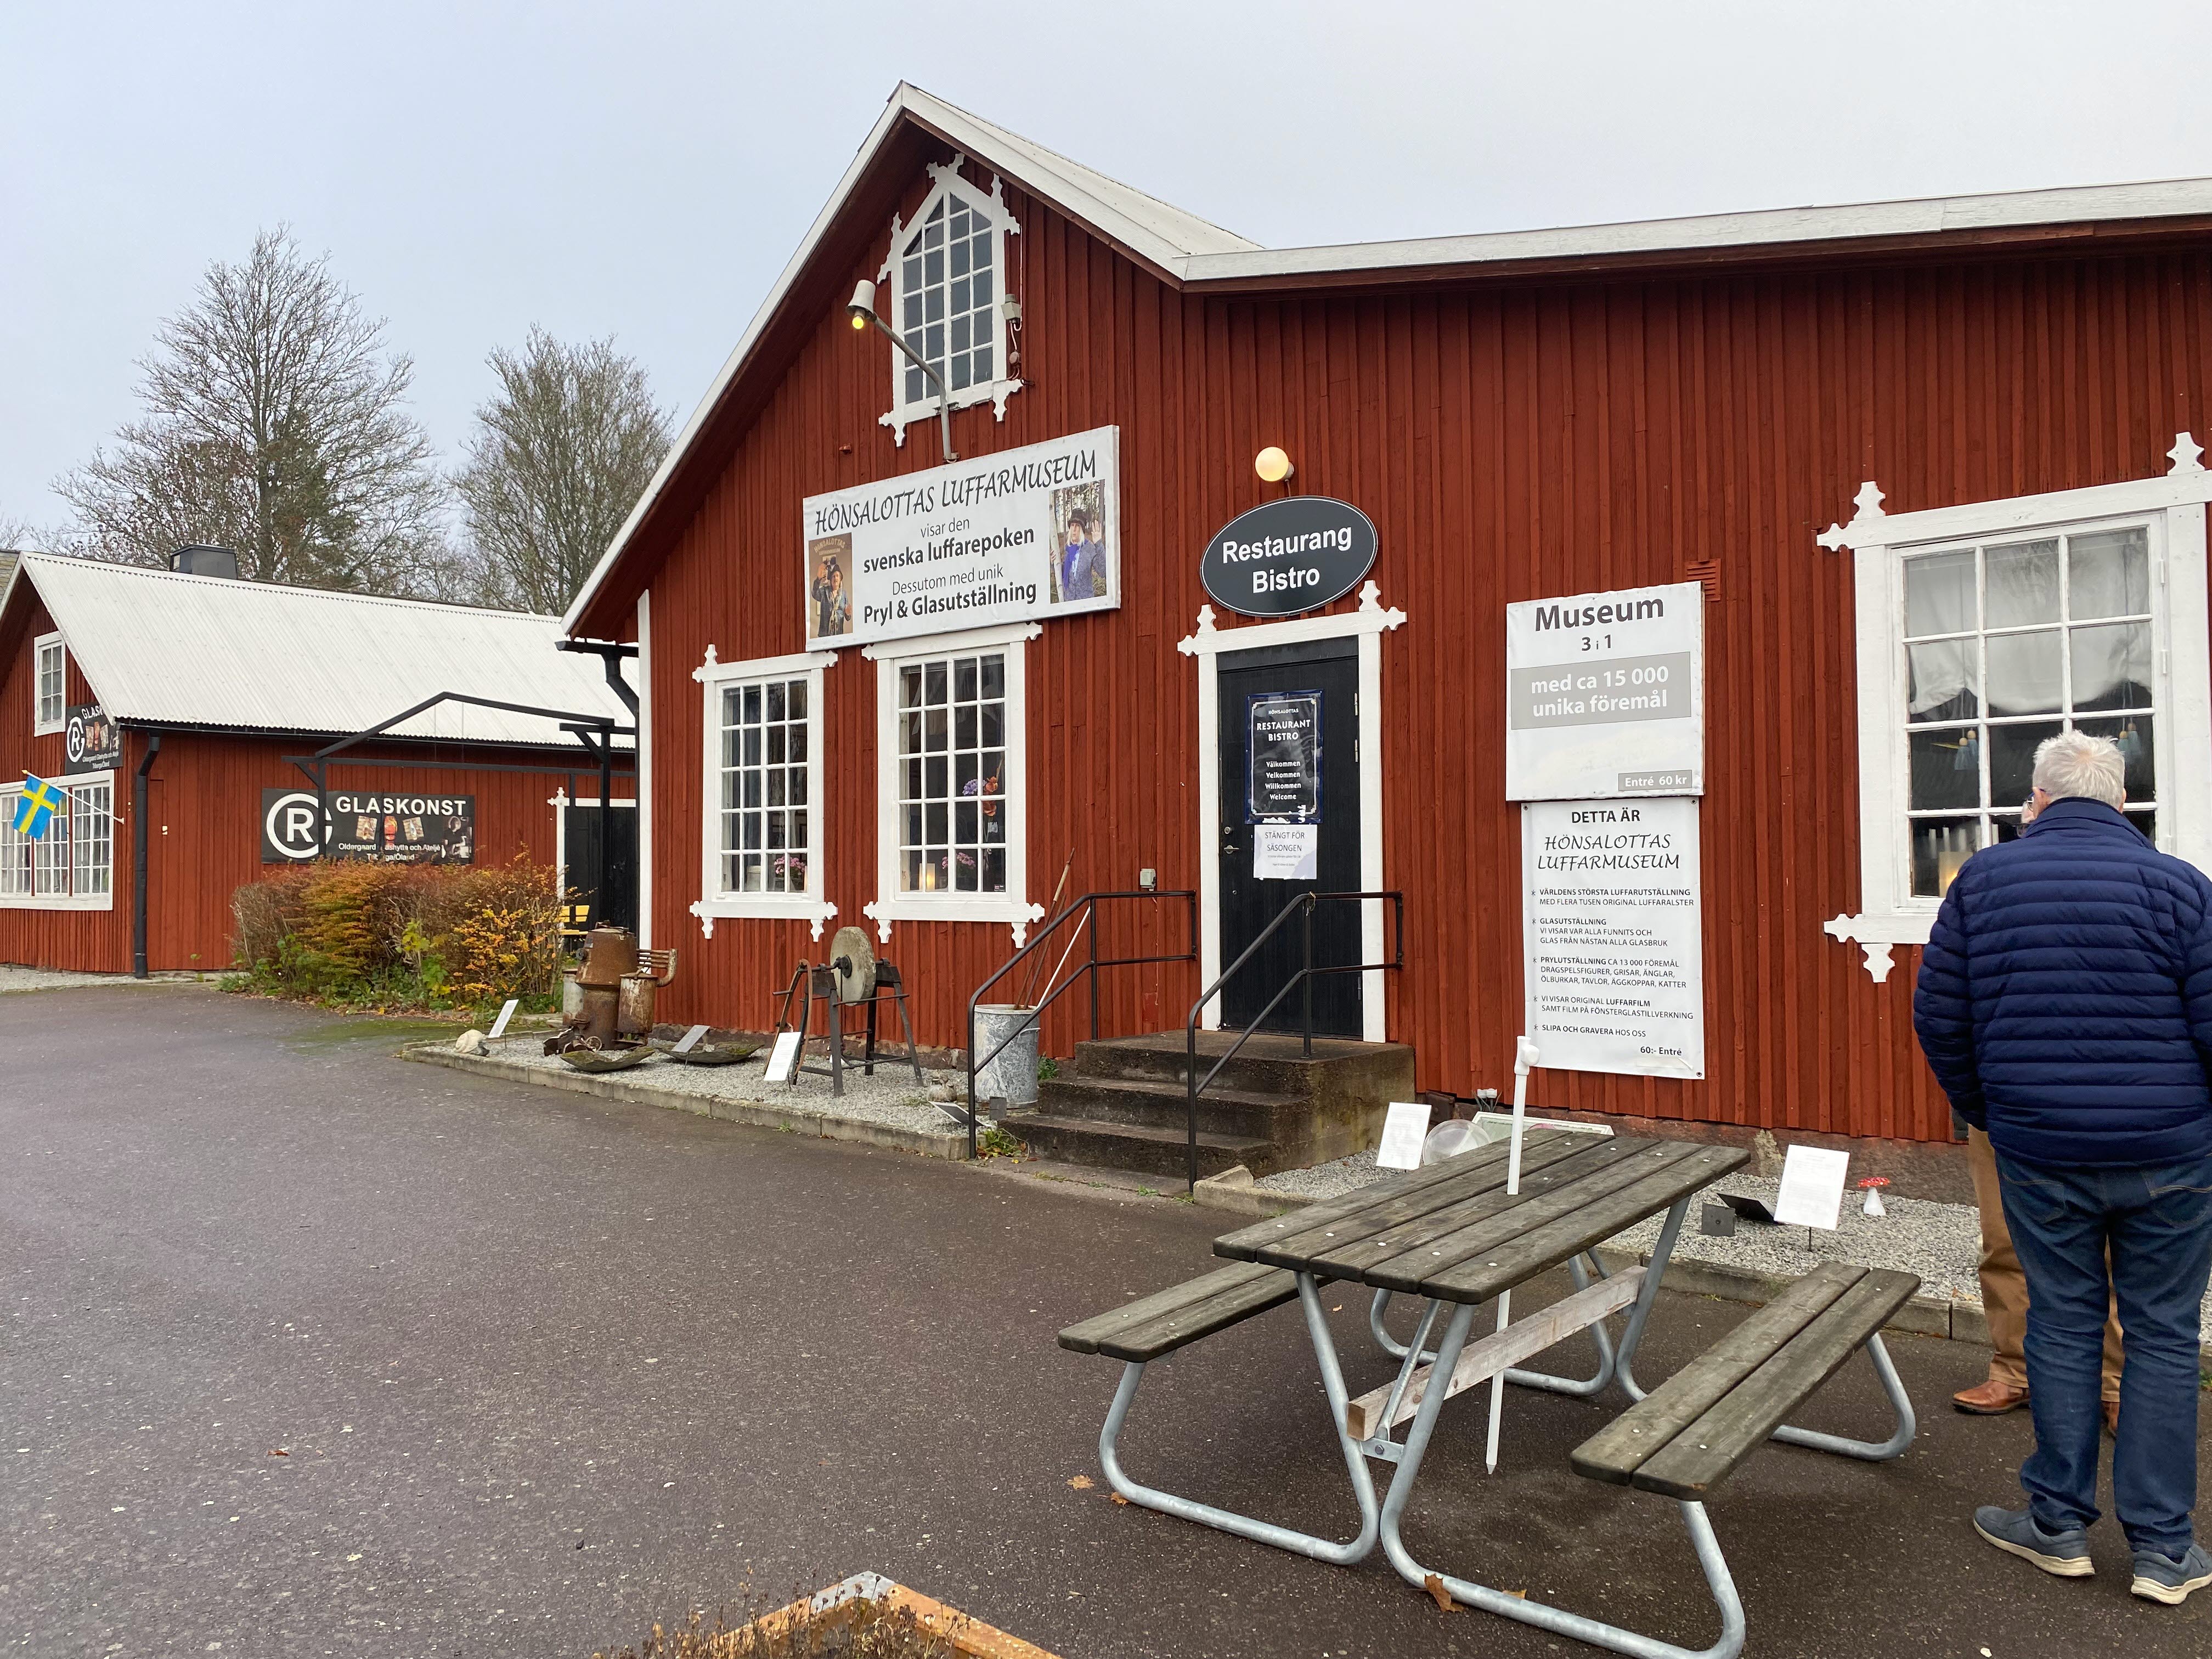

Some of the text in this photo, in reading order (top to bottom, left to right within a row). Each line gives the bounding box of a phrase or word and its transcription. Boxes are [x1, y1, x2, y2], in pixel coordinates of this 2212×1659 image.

[815, 450, 1095, 535] HÖNSALOTTAS LUFFARMUSEUM
[921, 517, 969, 538] visar den
[864, 527, 1034, 573] svenska luffarepoken
[1223, 527, 1351, 563] Restaurang
[892, 564, 1003, 595] Dessutom med unik
[1252, 567, 1320, 594] Bistro
[864, 582, 1036, 626] Pryl & Glasutställning
[1536, 598, 1663, 631] Museum
[1582, 637, 1591, 651] 3
[1604, 634, 1611, 648] 1
[1532, 665, 1668, 693] med ca 15 000
[1533, 689, 1667, 716] unika föremål
[1256, 720, 1311, 730] RESTAURANT
[1268, 732, 1299, 741] BISTRO
[1625, 775, 1687, 787] Entré 60 kr
[336, 796, 466, 816] GLASKONST
[1572, 807, 1640, 823] DETTA ÄR
[1265, 831, 1305, 839] STÄNGT FÖR
[1544, 833, 1671, 851] HÖNSALOTTAS
[1267, 843, 1302, 851] SÄSONGEN
[1538, 853, 1679, 871] LUFFARMUSEUM
[1611, 888, 1690, 896] LUFFARUTSTÄLLNING
[1540, 917, 1606, 926] GLASUTSTÄLLNING
[1560, 936, 1578, 945] FRÅN
[1580, 936, 1607, 945] NÄSTAN
[1541, 957, 1606, 965] PRYLUTSTÄLLNING
[1645, 959, 1680, 967] FÖREMÅL
[1541, 966, 1612, 975] DRAGSPELSFIGURER,
[1643, 968, 1675, 978] ÄNGLAR,
[1541, 975, 1580, 984] ÖLBURKAR,
[1581, 977, 1610, 985] TAVLOR,
[1611, 977, 1656, 987] ÄGGKOPPAR,
[1606, 998, 1650, 1007] LUFFARFILM
[1580, 1006, 1589, 1014] PÅ
[1590, 1006, 1694, 1019] FÖNSTERGLASTILLVERKNING
[1580, 1027, 1613, 1035] GRAVERA
[1640, 1046, 1682, 1056] 60:- Entré
